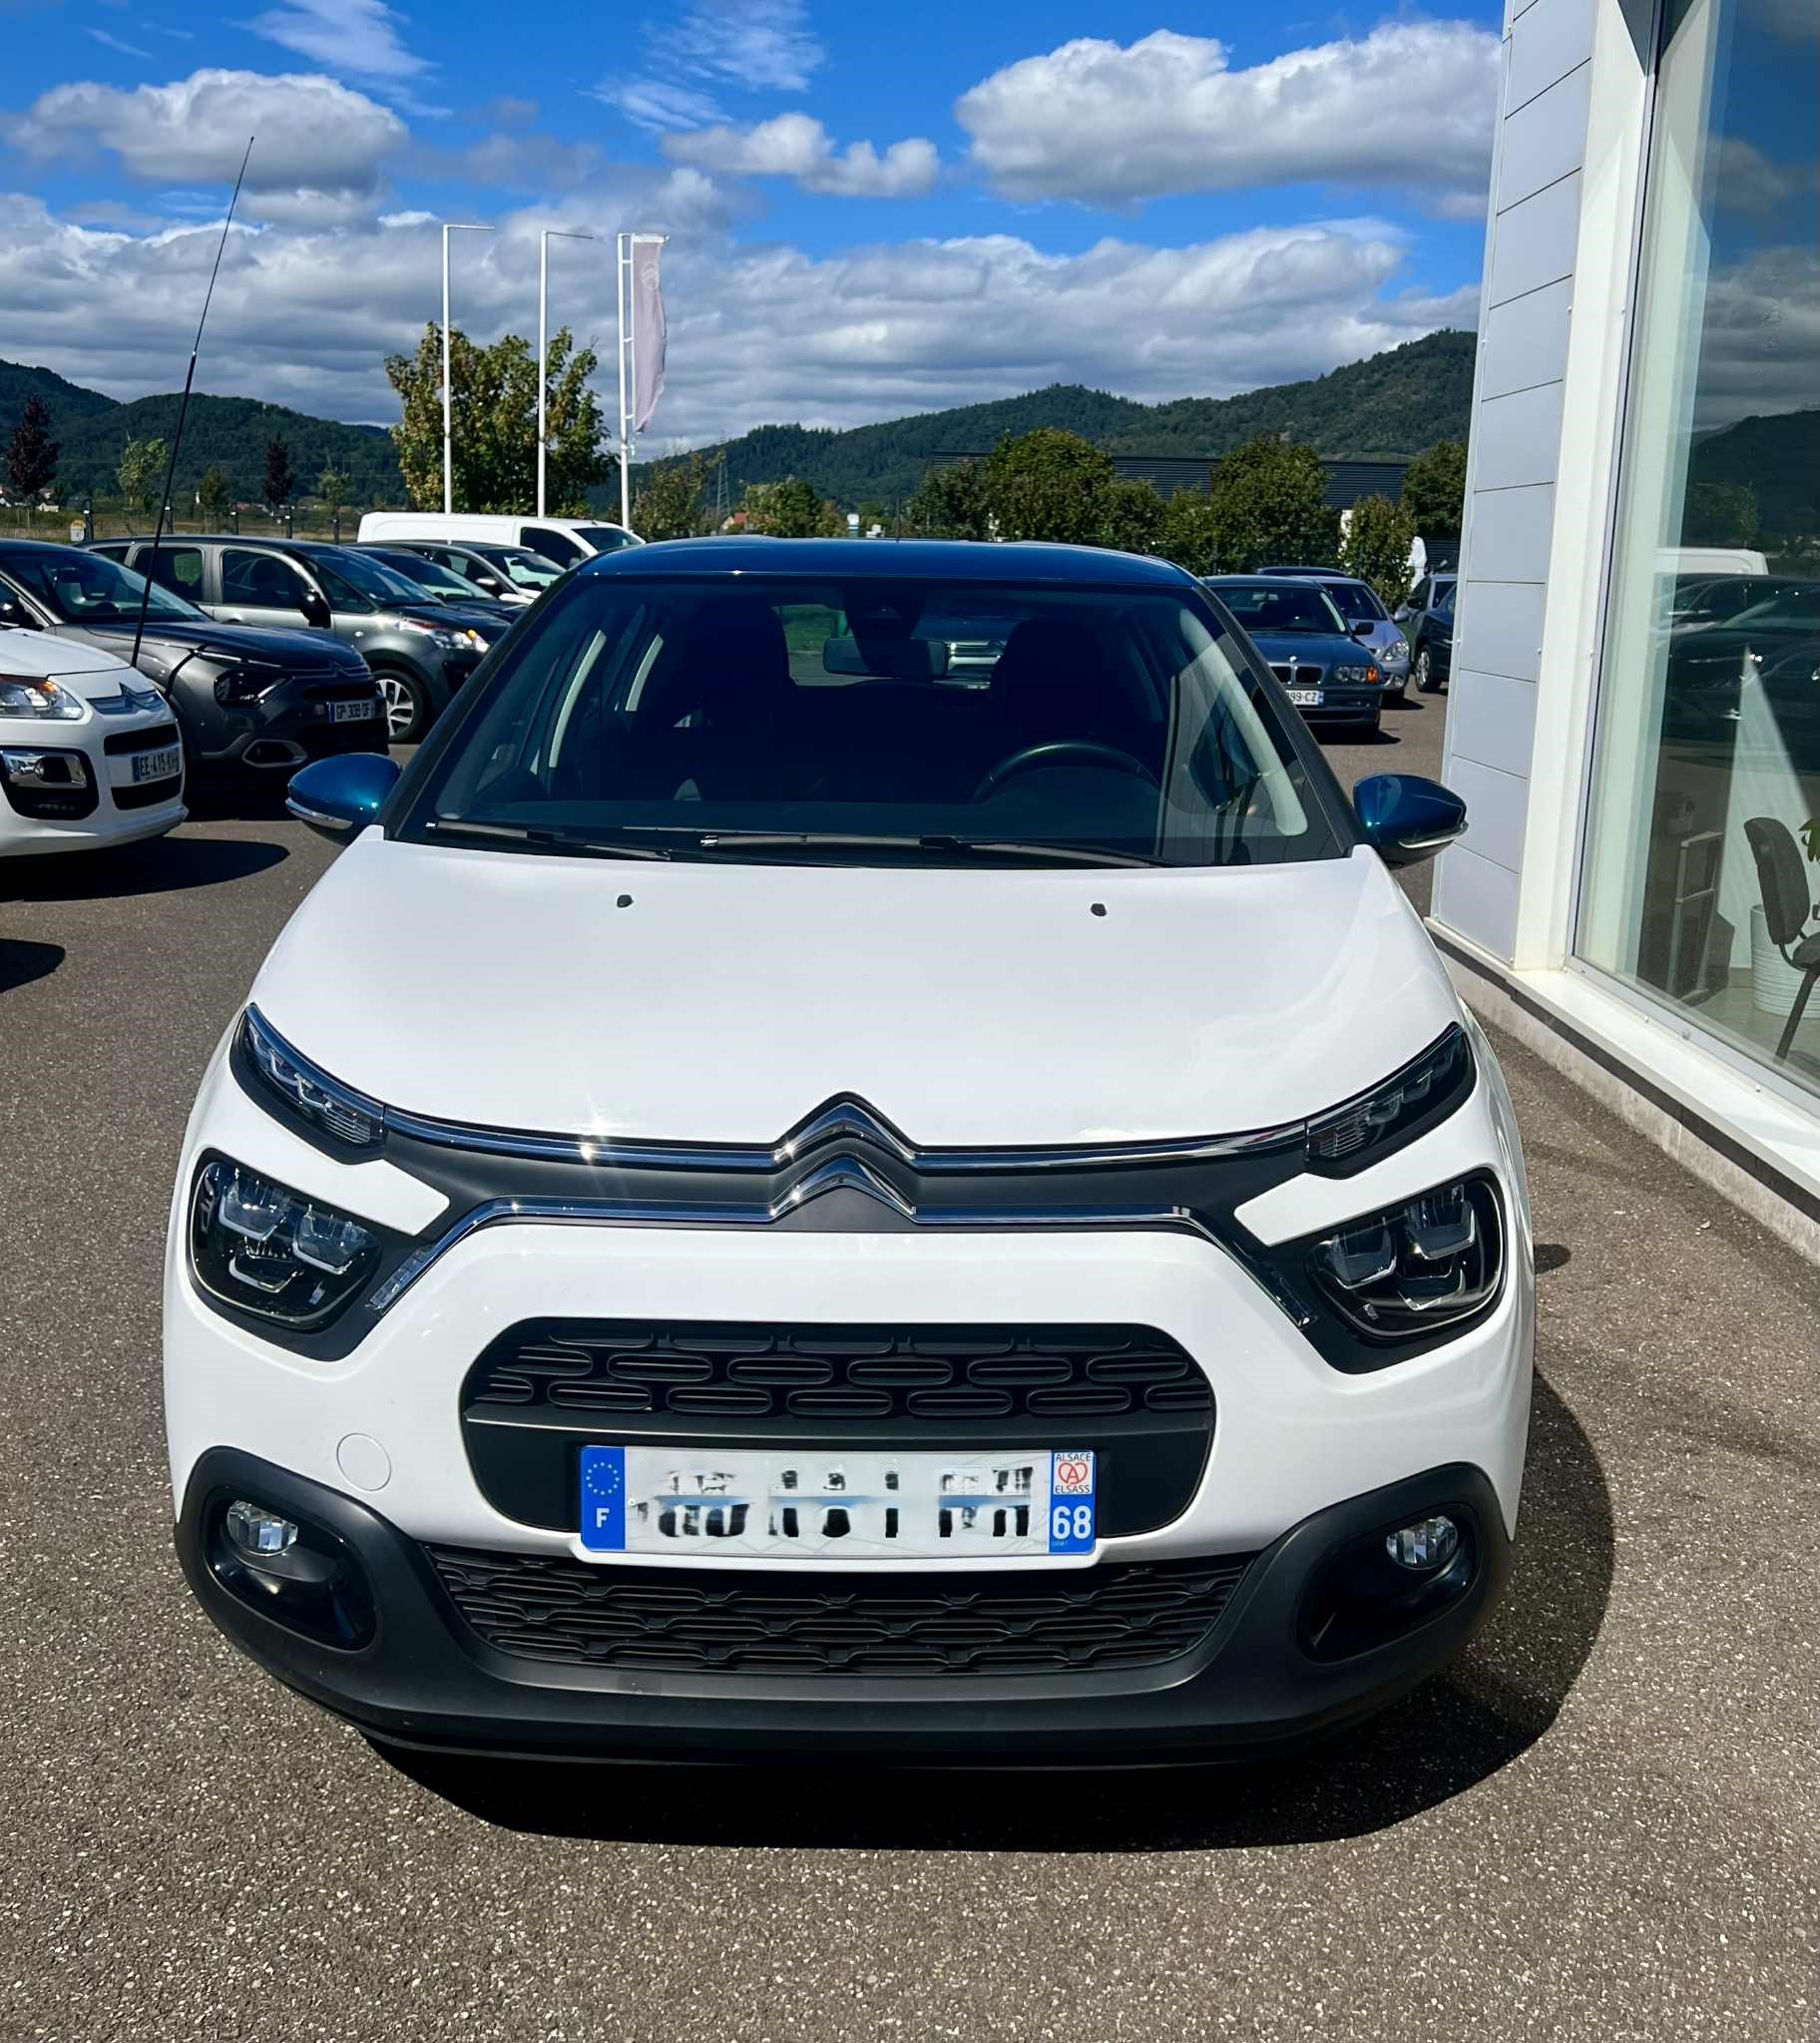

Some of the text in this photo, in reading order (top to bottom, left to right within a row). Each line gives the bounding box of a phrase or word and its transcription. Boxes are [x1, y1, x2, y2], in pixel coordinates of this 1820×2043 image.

[1055, 1453, 1092, 1462] ALSACE
[1055, 1484, 1091, 1494] ELSASS
[596, 1507, 611, 1529] F
[1052, 1505, 1092, 1540] 68
